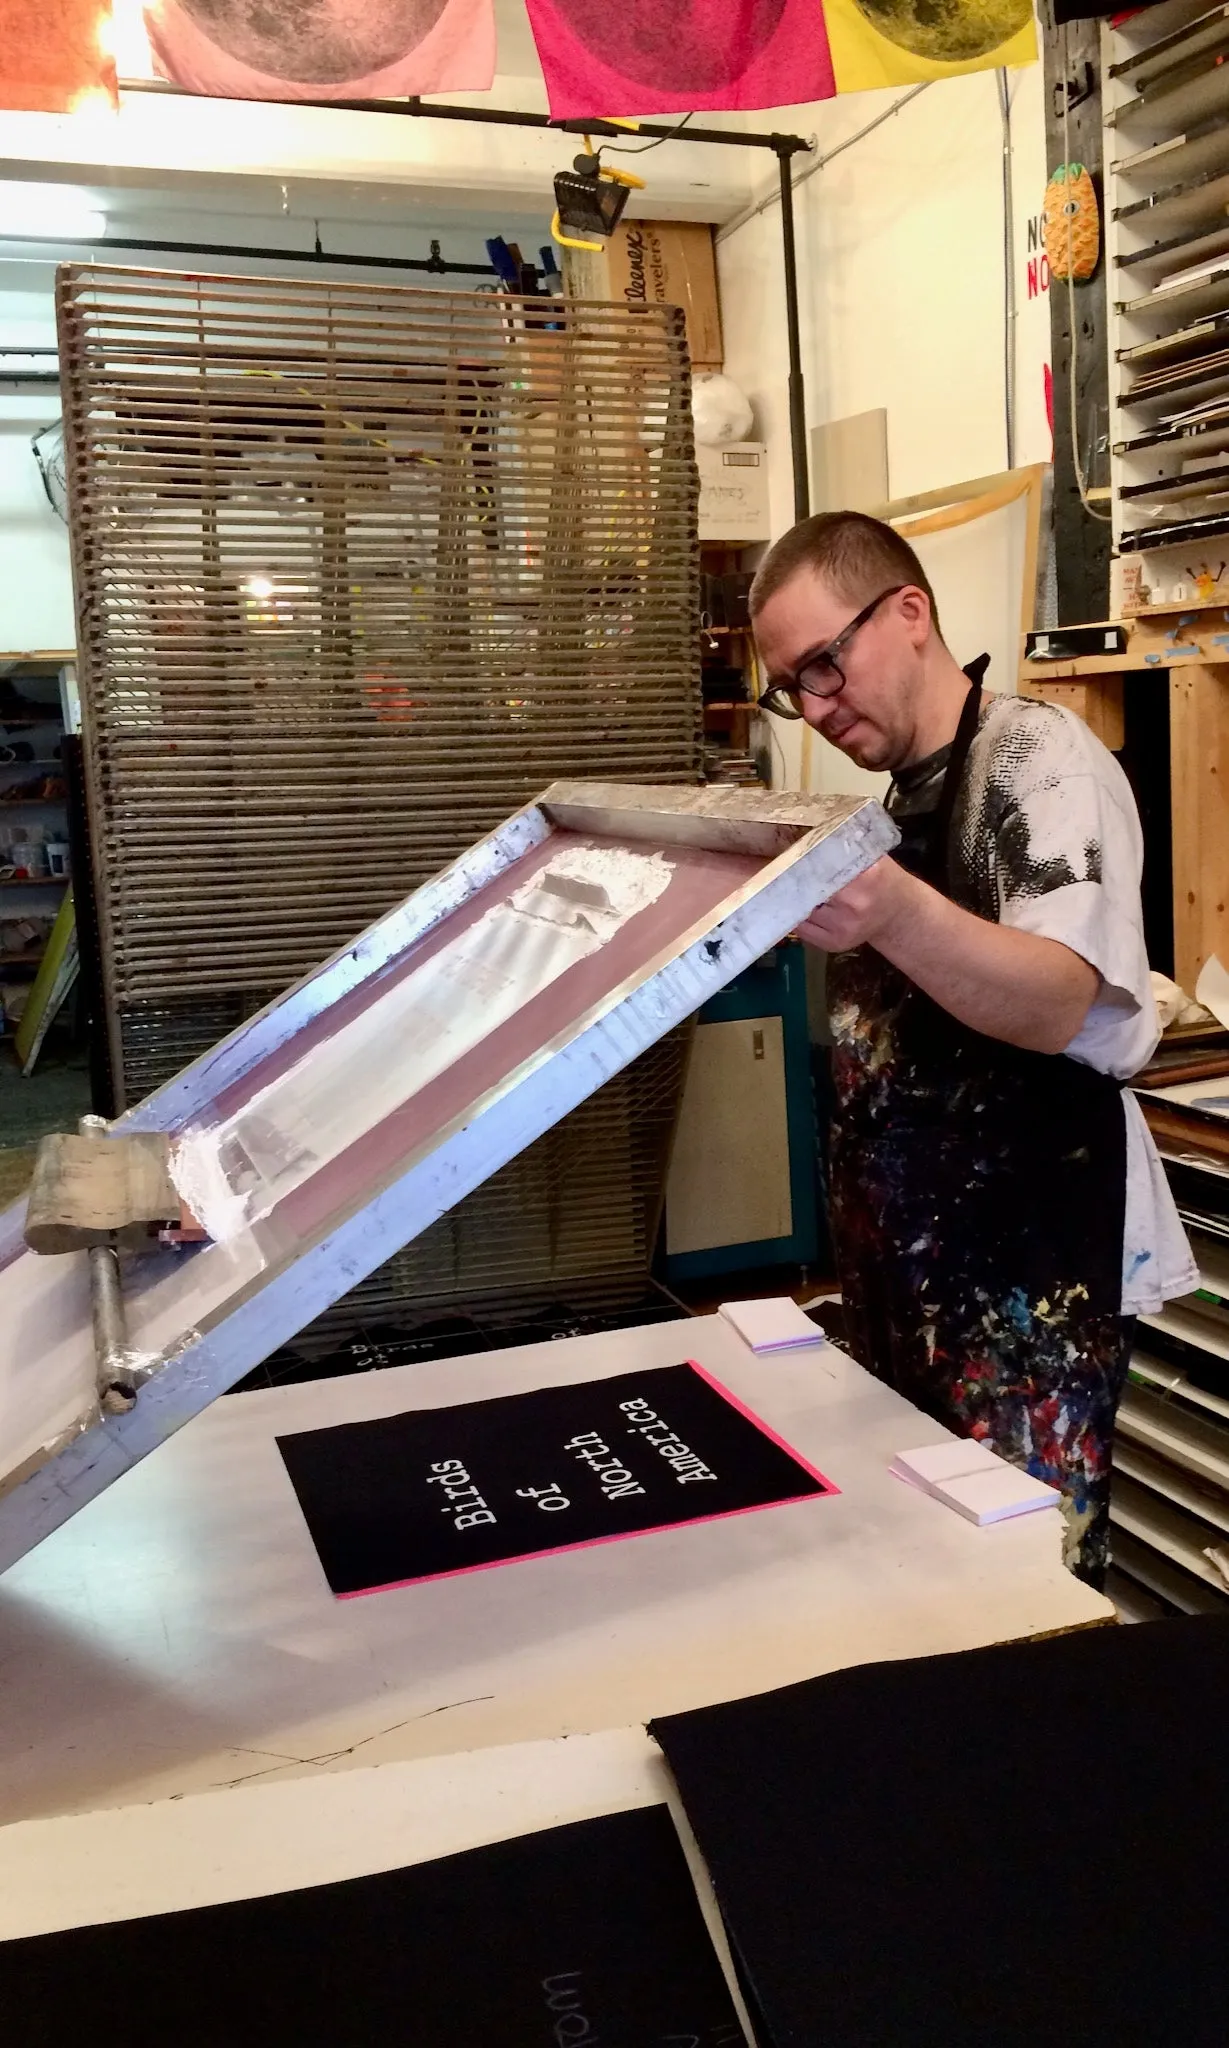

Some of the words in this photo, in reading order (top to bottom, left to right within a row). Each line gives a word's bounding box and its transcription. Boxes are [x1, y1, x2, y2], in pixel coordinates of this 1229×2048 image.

[1027, 254, 1050, 300] NO
[564, 1431, 646, 1501] North
[619, 1397, 718, 1485] America
[426, 1459, 497, 1531] Birds
[515, 1483, 571, 1512] of
